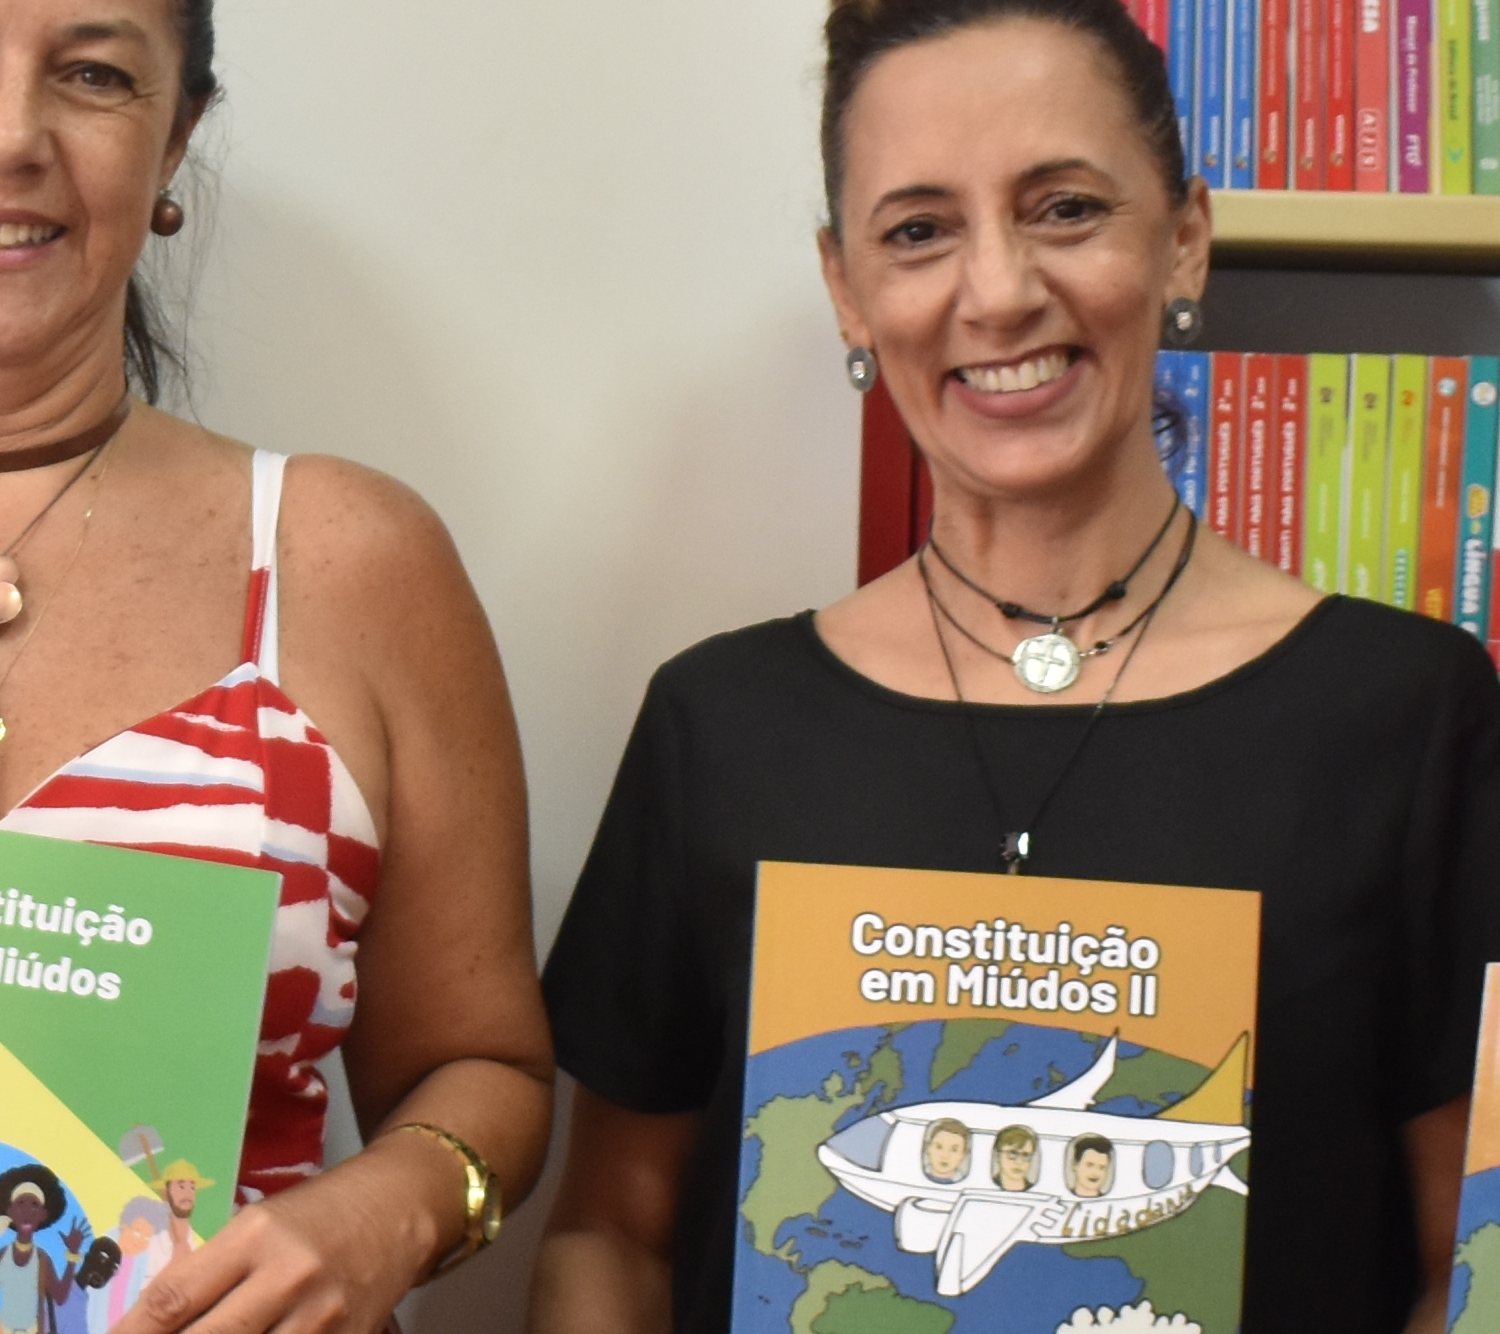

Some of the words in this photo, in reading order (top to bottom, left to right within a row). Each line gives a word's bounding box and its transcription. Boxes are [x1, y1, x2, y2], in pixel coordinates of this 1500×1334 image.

[851, 912, 1160, 975] Constituição
[859, 967, 935, 1005] em
[945, 965, 1118, 1016] Miúdos
[1129, 975, 1158, 1017] II
